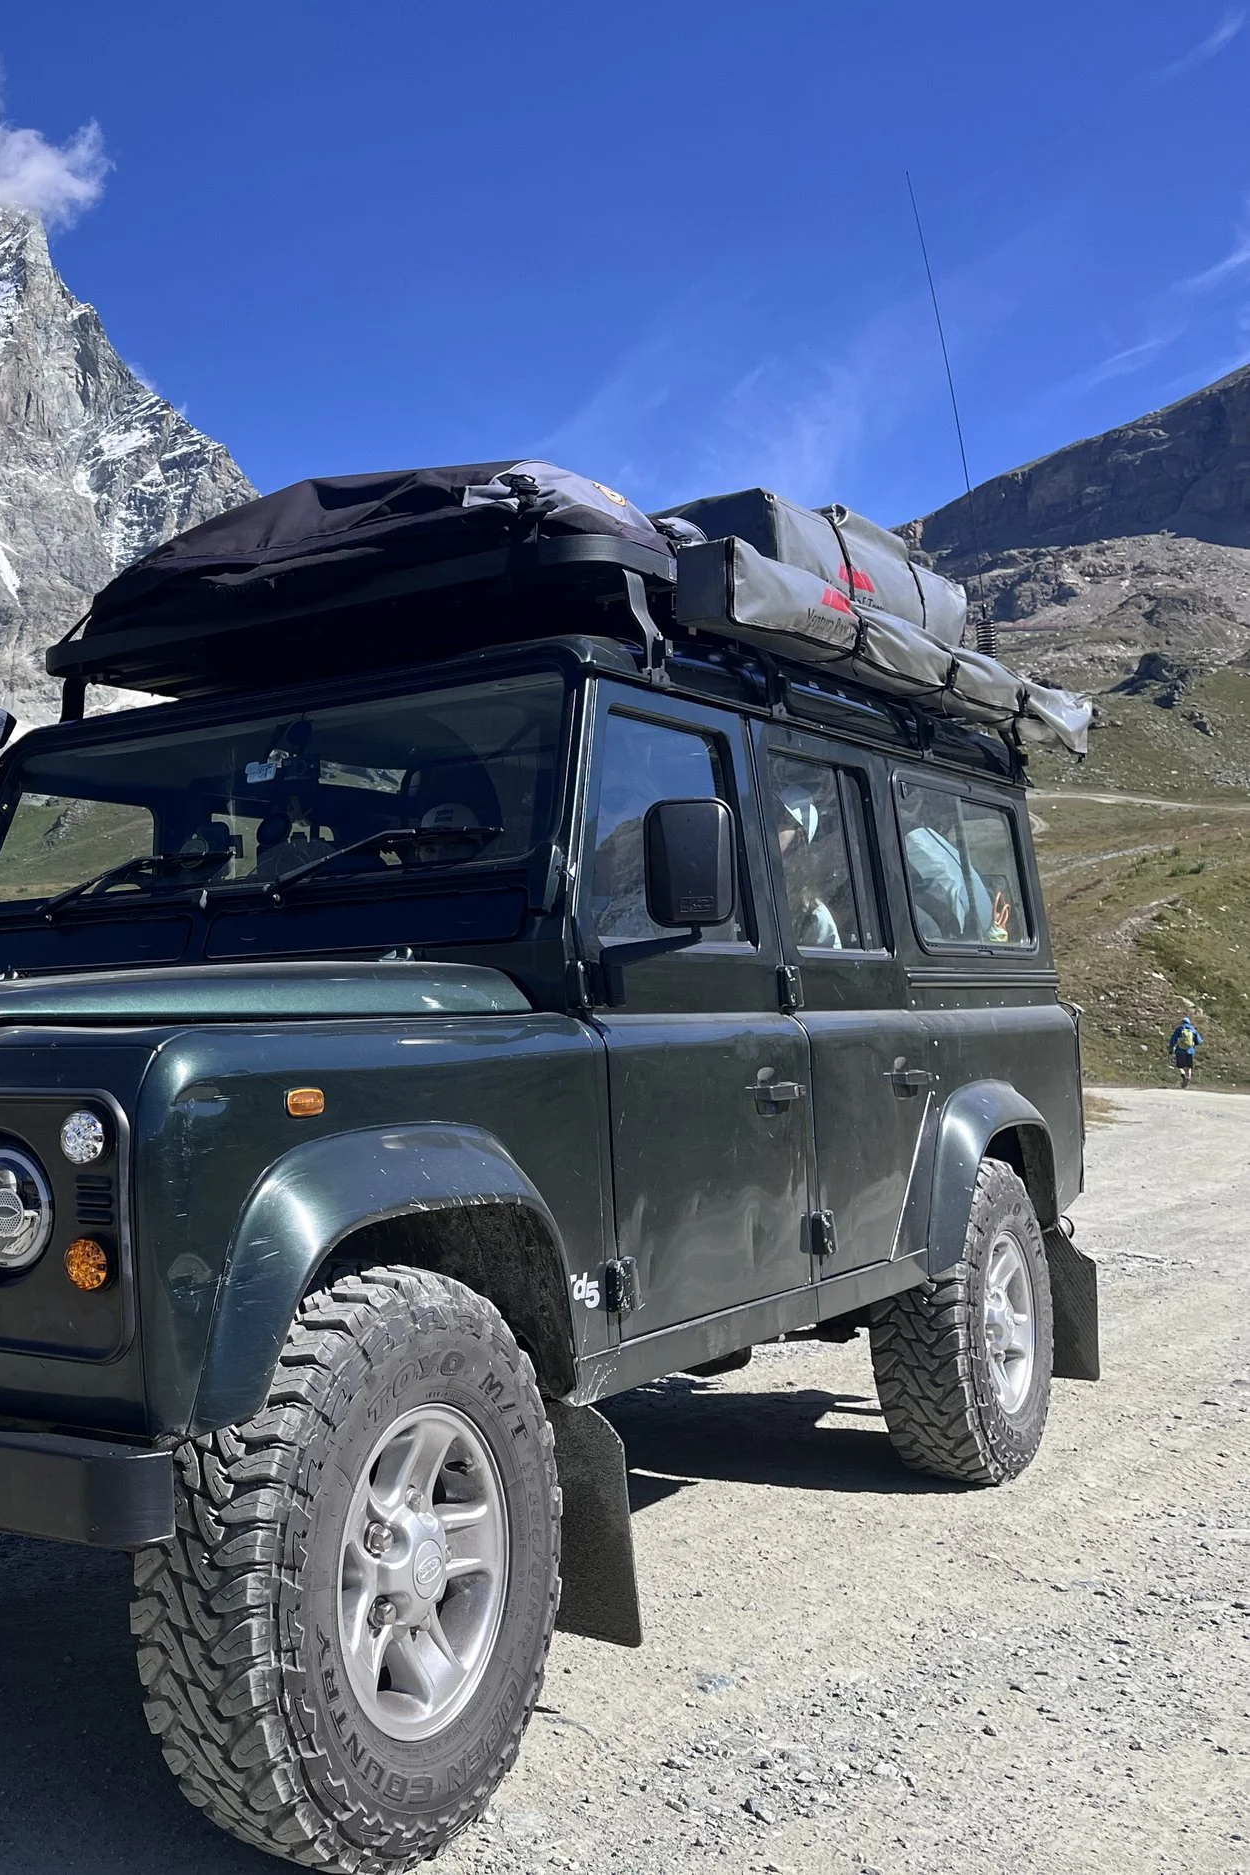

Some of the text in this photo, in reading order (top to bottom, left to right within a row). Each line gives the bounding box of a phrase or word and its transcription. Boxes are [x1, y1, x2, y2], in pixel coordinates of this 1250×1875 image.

[367, 1350, 466, 1423] TOYO
[317, 1623, 434, 1804] COUNTRY
[446, 1678, 521, 1794] OPEN
